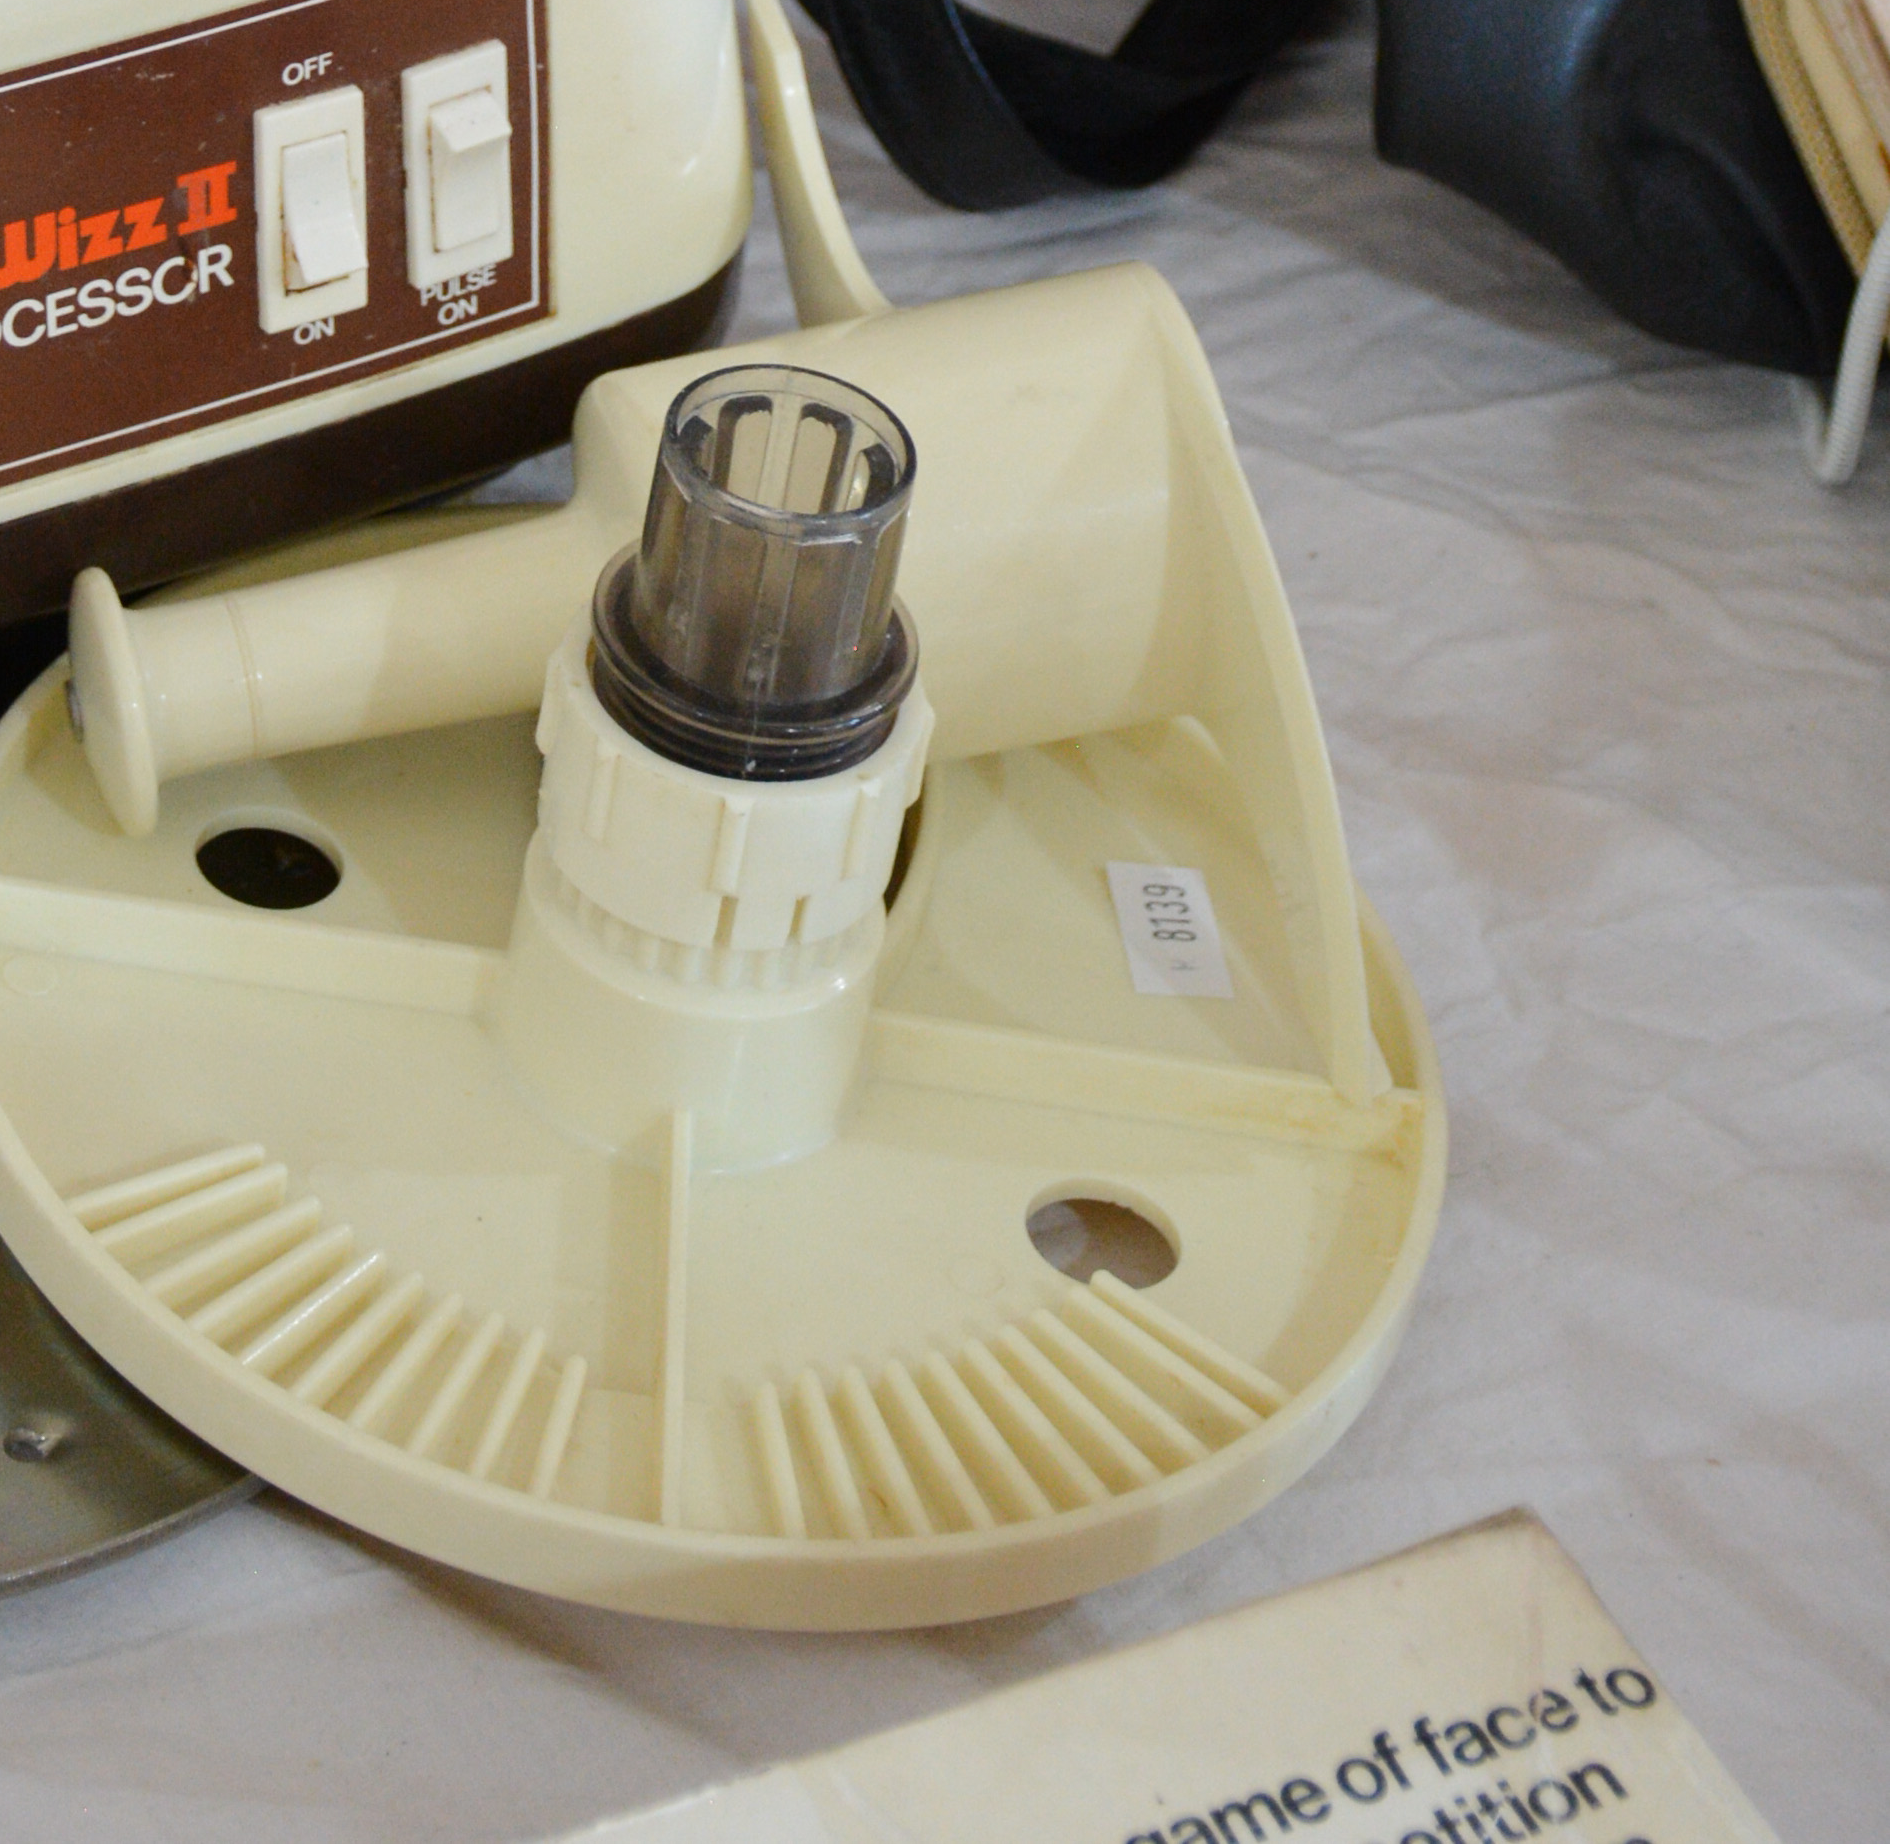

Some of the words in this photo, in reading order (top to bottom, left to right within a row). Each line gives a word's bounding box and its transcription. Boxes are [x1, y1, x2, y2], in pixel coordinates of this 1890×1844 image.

[281, 52, 333, 86] OFF
[177, 160, 236, 236] II
[420, 263, 497, 307] PULSE
[437, 294, 478, 325] ON
[293, 316, 335, 345] ON
[1143, 883, 1197, 942] 8139
[1124, 1778, 1332, 1844] ame
[1336, 1731, 1411, 1803] of
[1413, 1688, 1579, 1777] face
[1574, 1666, 1657, 1717] to
[1401, 1762, 1628, 1844] tition
